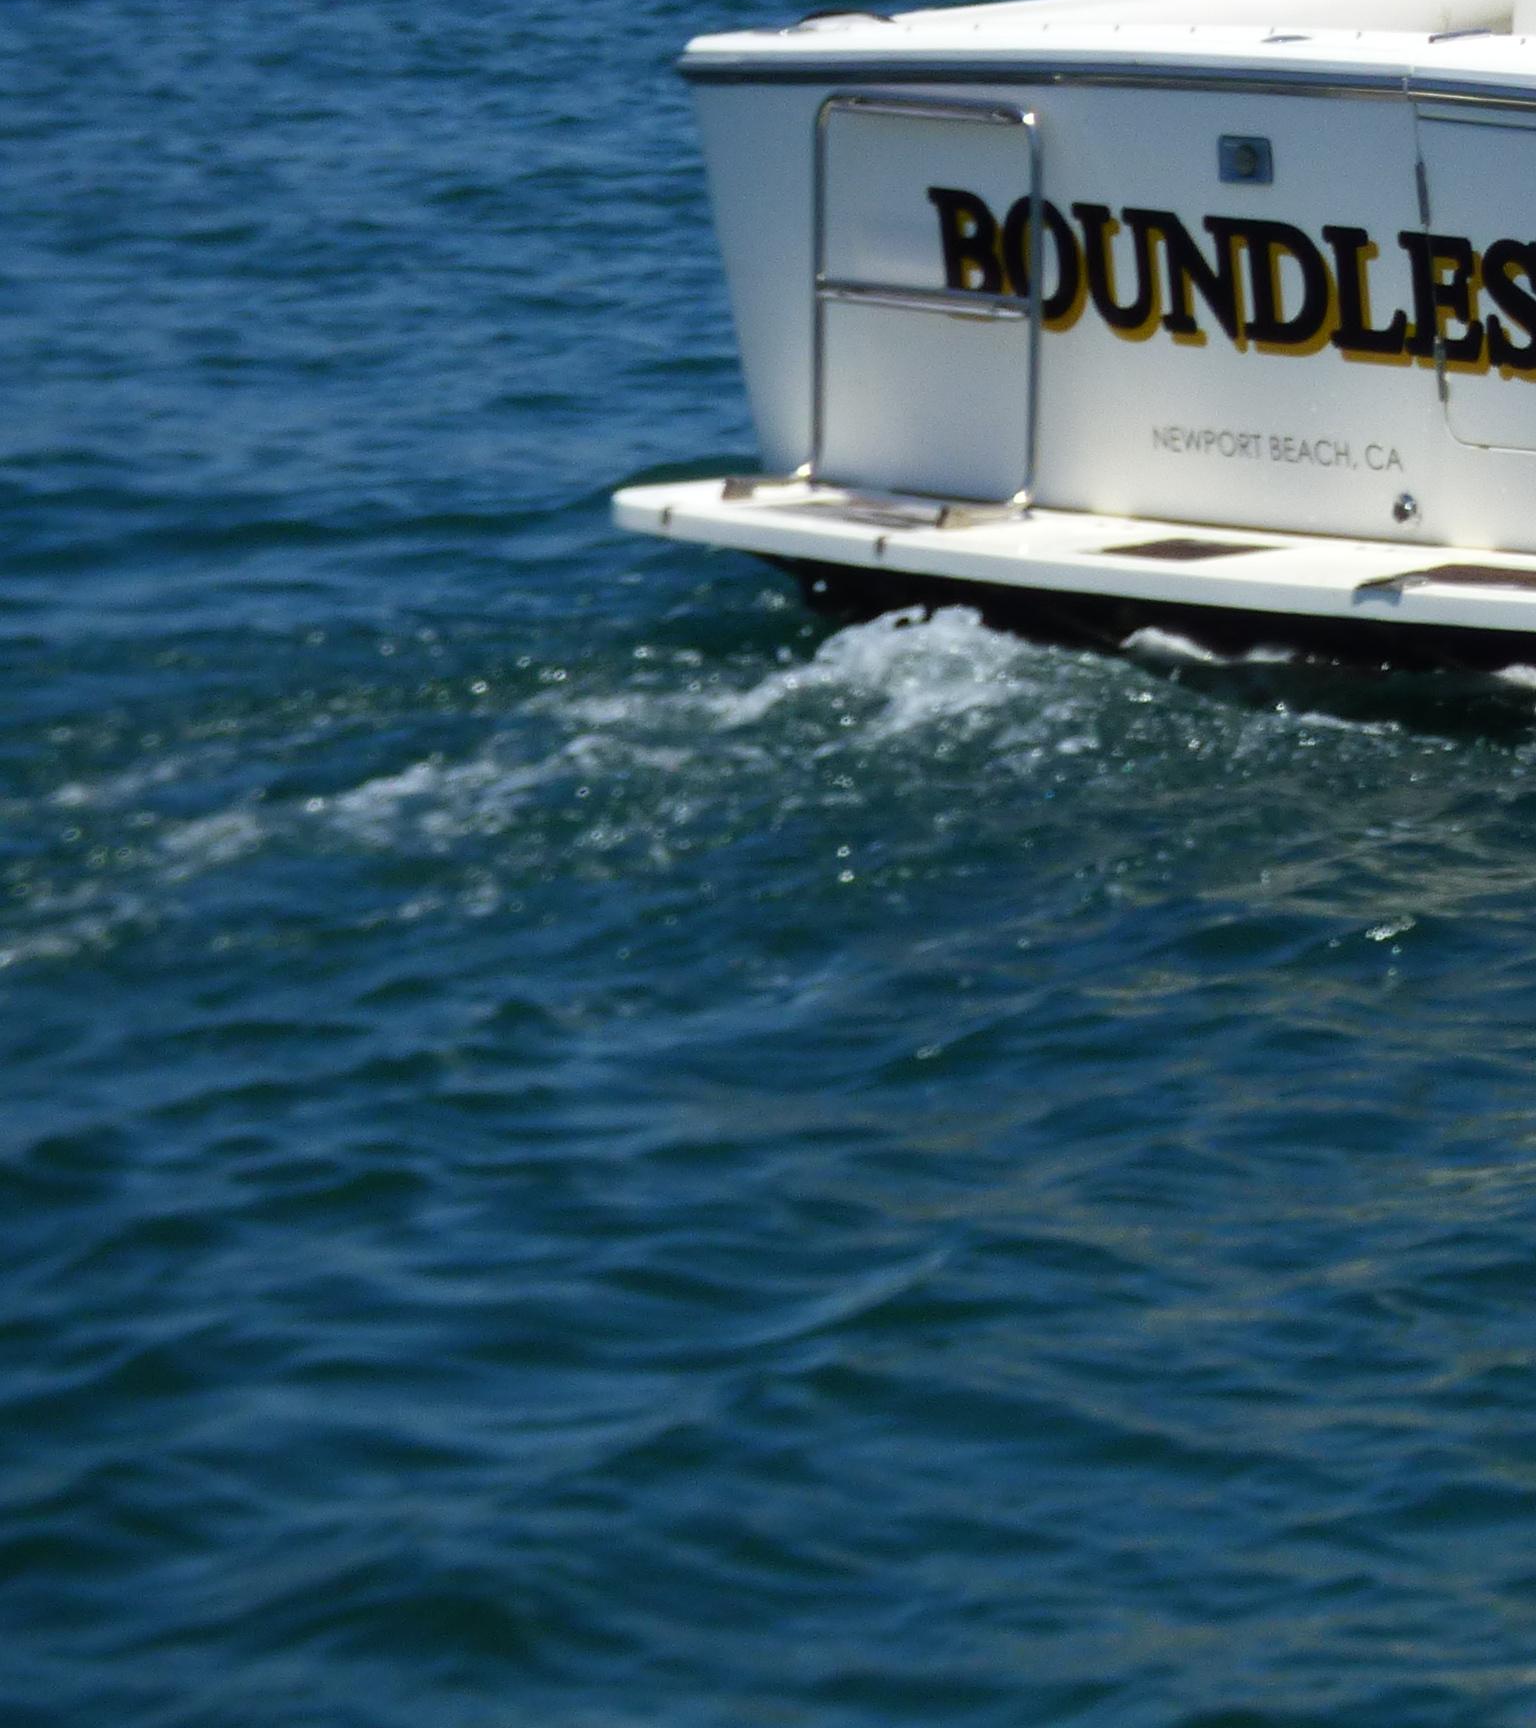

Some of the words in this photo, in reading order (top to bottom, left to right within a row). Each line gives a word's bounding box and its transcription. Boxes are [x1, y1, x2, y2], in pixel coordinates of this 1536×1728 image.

[1152, 426, 1261, 460] NEWPORT
[1268, 435, 1357, 468] BEACH,
[1364, 444, 1405, 472] CA
